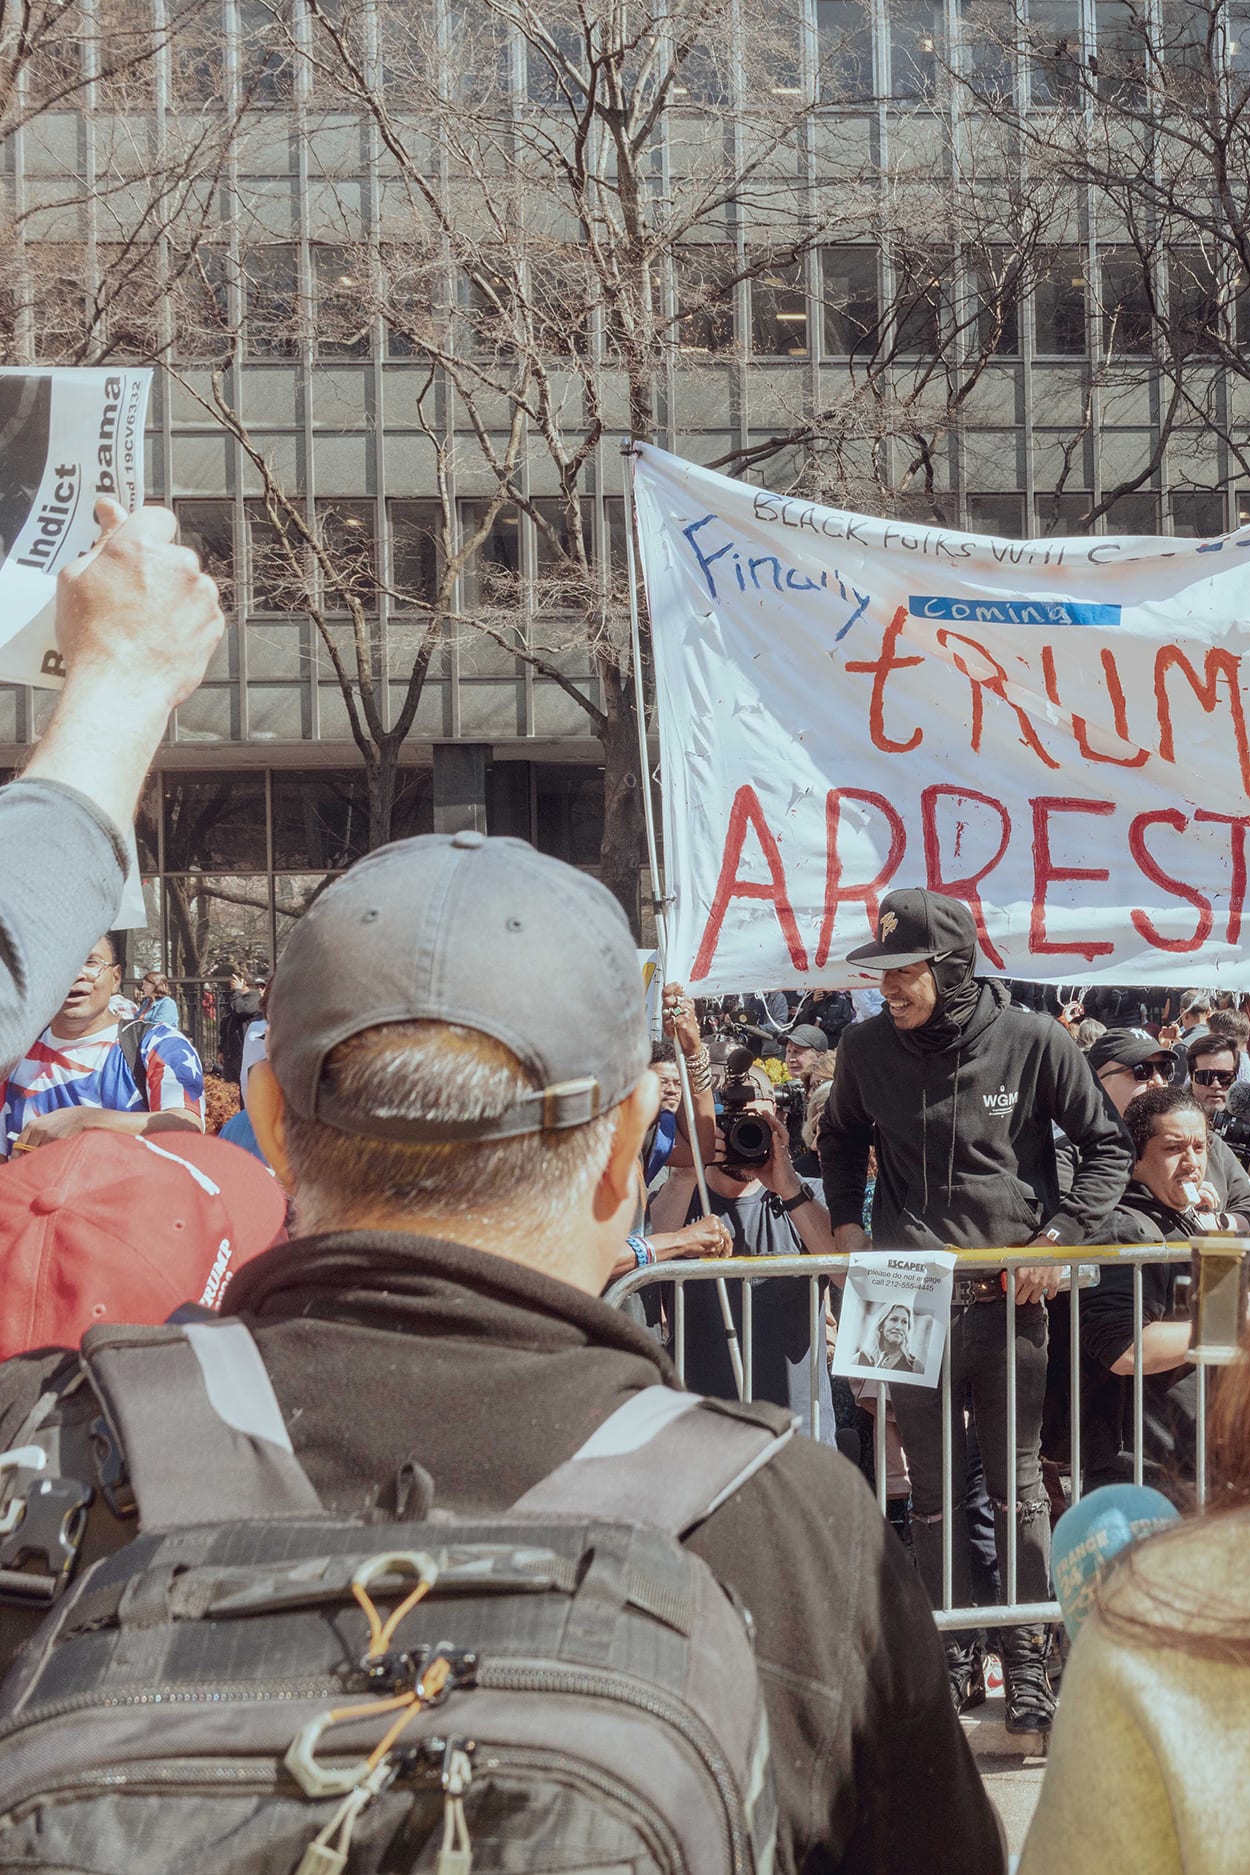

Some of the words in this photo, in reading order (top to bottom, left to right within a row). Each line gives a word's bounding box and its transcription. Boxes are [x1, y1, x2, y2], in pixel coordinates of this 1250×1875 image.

[95, 376, 121, 494] bama
[16, 463, 77, 568] Indict
[753, 491, 869, 546] BLACK
[682, 513, 871, 642] Finally
[982, 1091, 1019, 1108] WGM
[199, 1238, 233, 1307] RUMP
